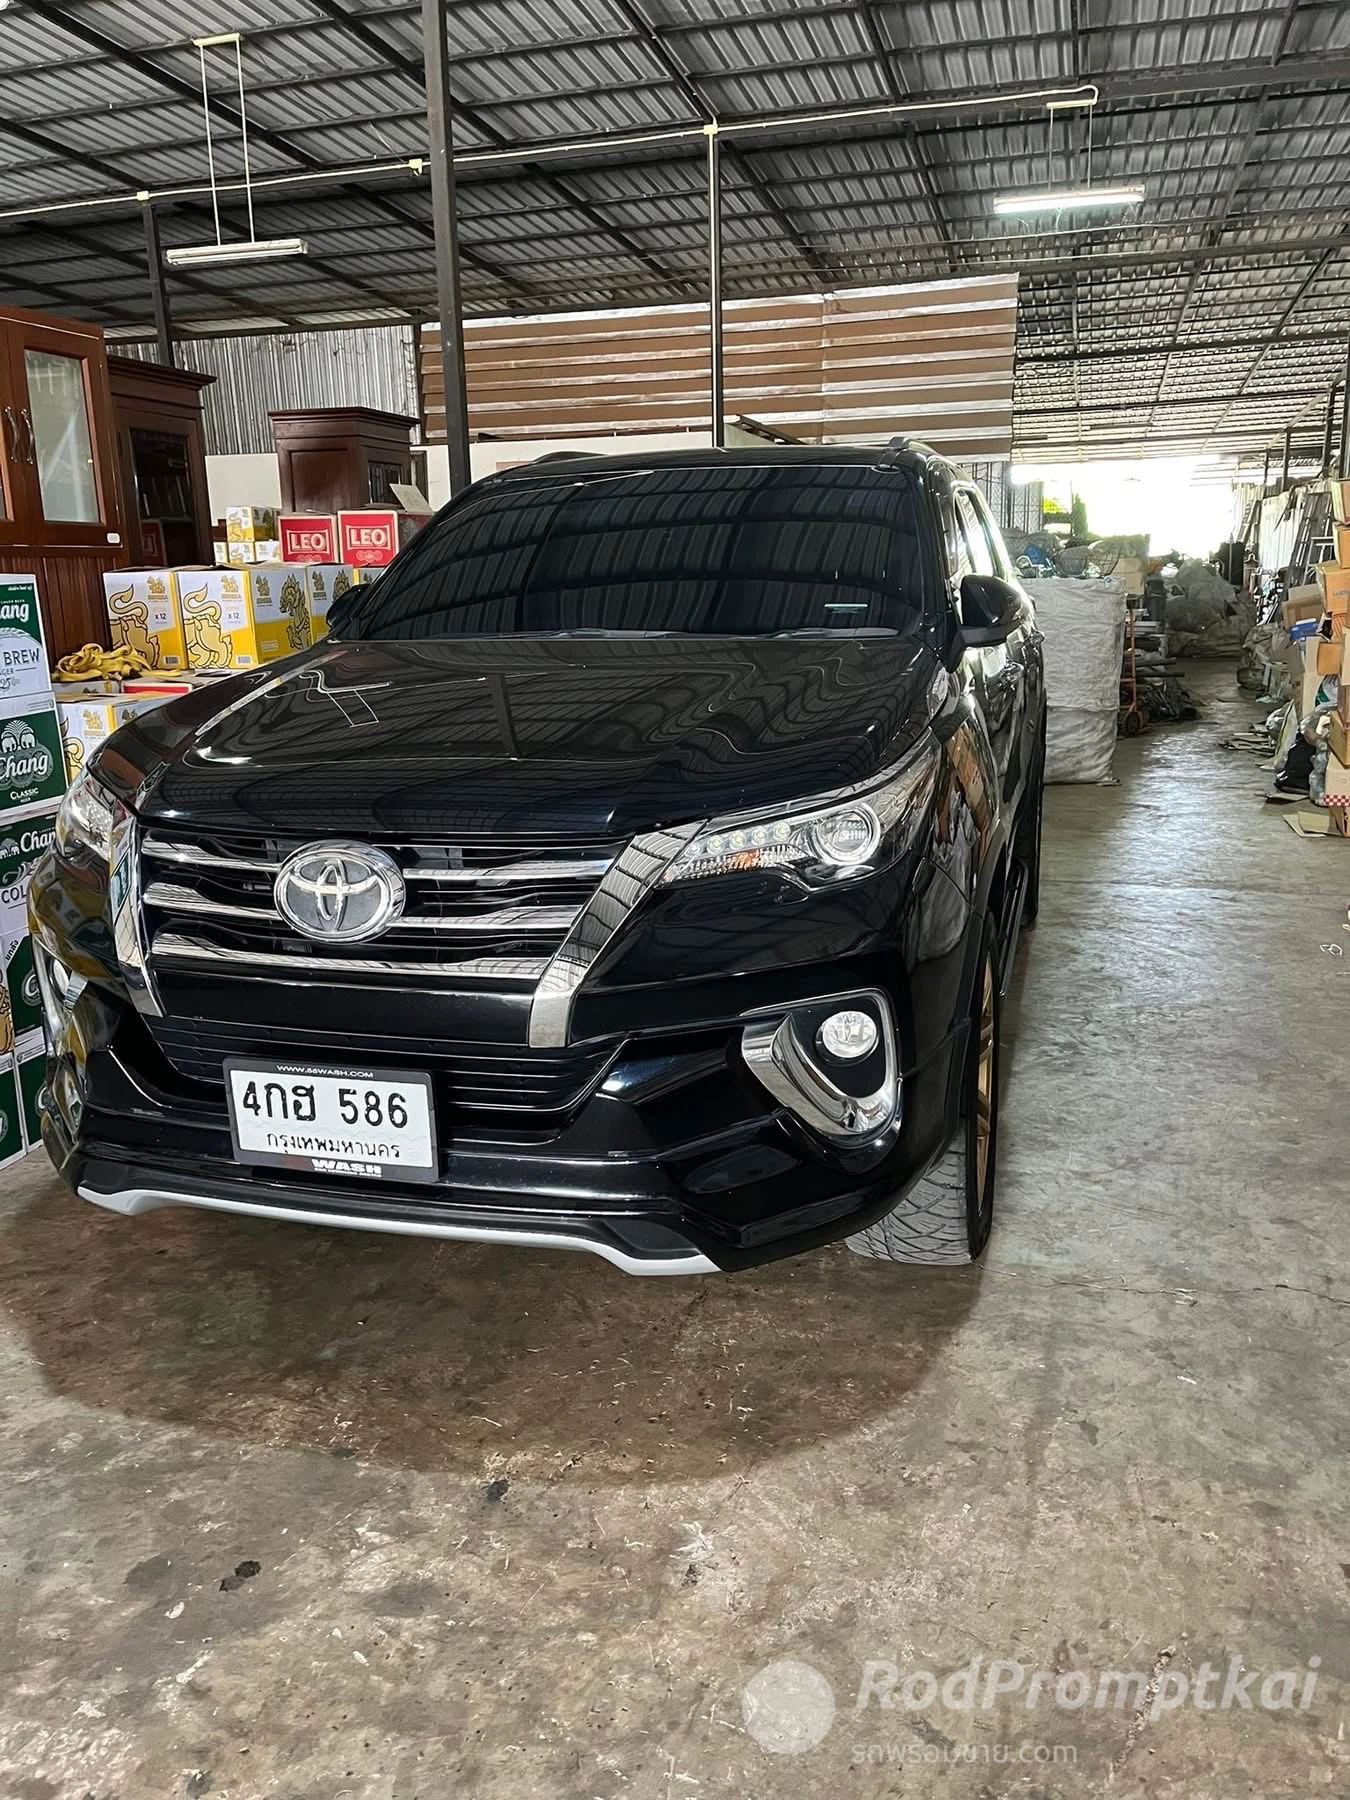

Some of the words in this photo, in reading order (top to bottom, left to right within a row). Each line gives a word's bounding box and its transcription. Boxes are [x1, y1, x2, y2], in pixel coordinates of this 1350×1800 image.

[290, 533, 325, 551] LEO
[350, 528, 387, 546] LEO
[0, 603, 29, 623] ang
[159, 612, 167, 620] 12
[3, 648, 40, 665] BREW
[0, 668, 14, 676] GER
[10, 787, 39, 800] CLASSIC
[20, 830, 56, 853] Chan
[1, 885, 27, 904] COL
[243, 1081, 316, 1122] 4กฮ
[338, 1088, 408, 1129] 586
[267, 1133, 401, 1158] กรุงเทพมหานคร
[312, 1159, 382, 1174] WASH
